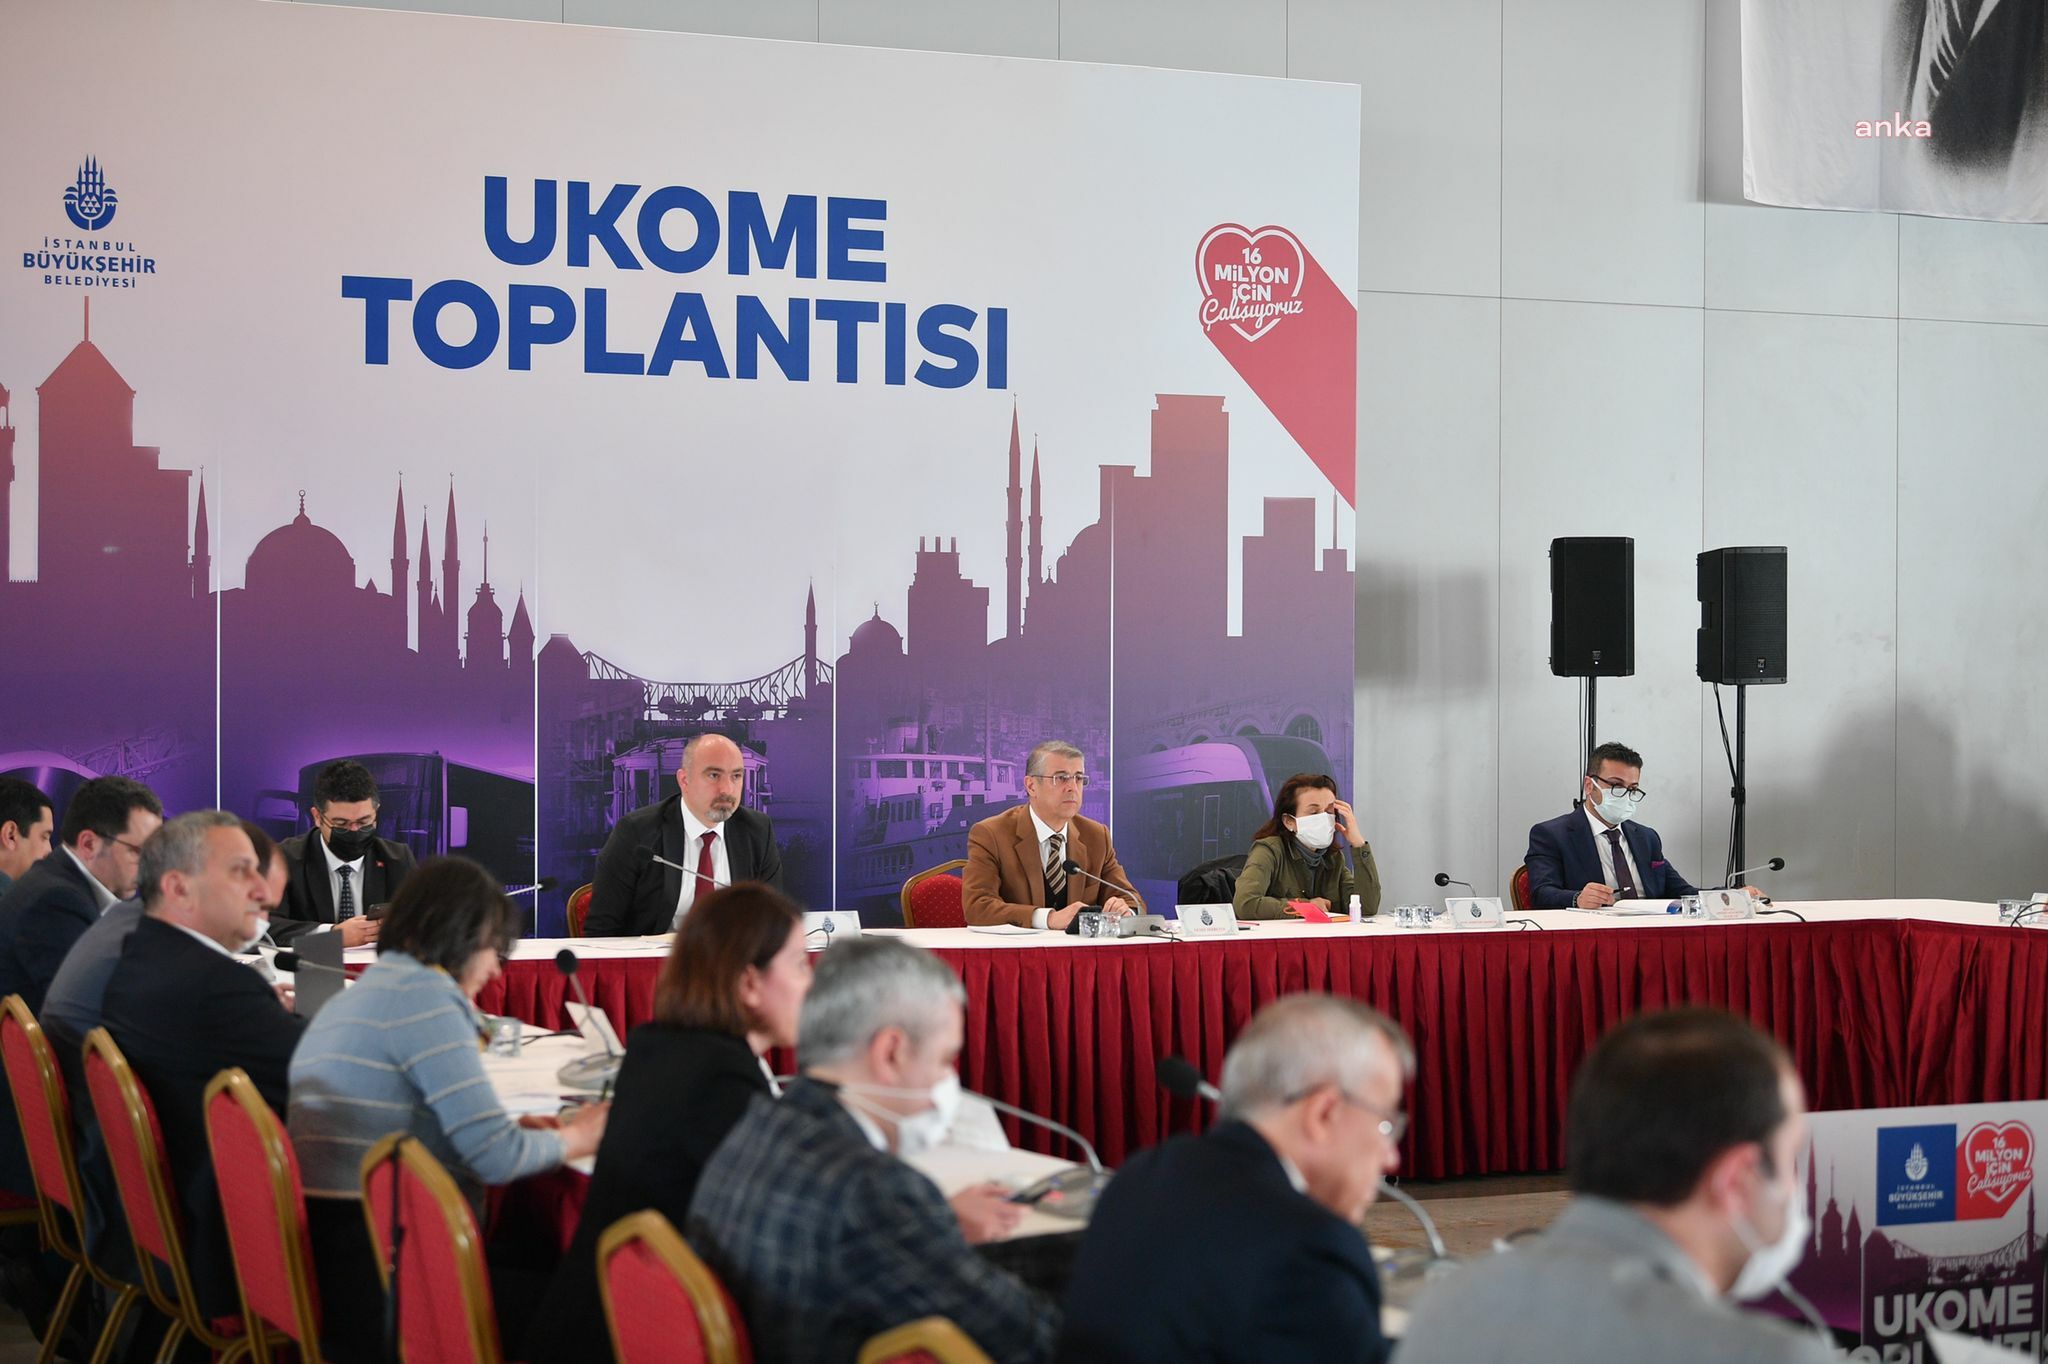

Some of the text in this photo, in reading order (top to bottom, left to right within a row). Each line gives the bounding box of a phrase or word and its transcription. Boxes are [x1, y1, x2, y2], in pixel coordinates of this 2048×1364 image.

[484, 175, 887, 283] UKOME
[44, 236, 136, 252] İSTANBUL
[1242, 247, 1262, 265] 16
[23, 250, 156, 274] BÜYÜKŞEHİR
[44, 275, 136, 288] BELEDİYESİ
[1202, 296, 1304, 332] Çalışıyoruz
[341, 275, 1008, 390] TOPLANTISI
[1992, 1136, 2006, 1149] 16
[1873, 1283, 2034, 1338] UKOME
